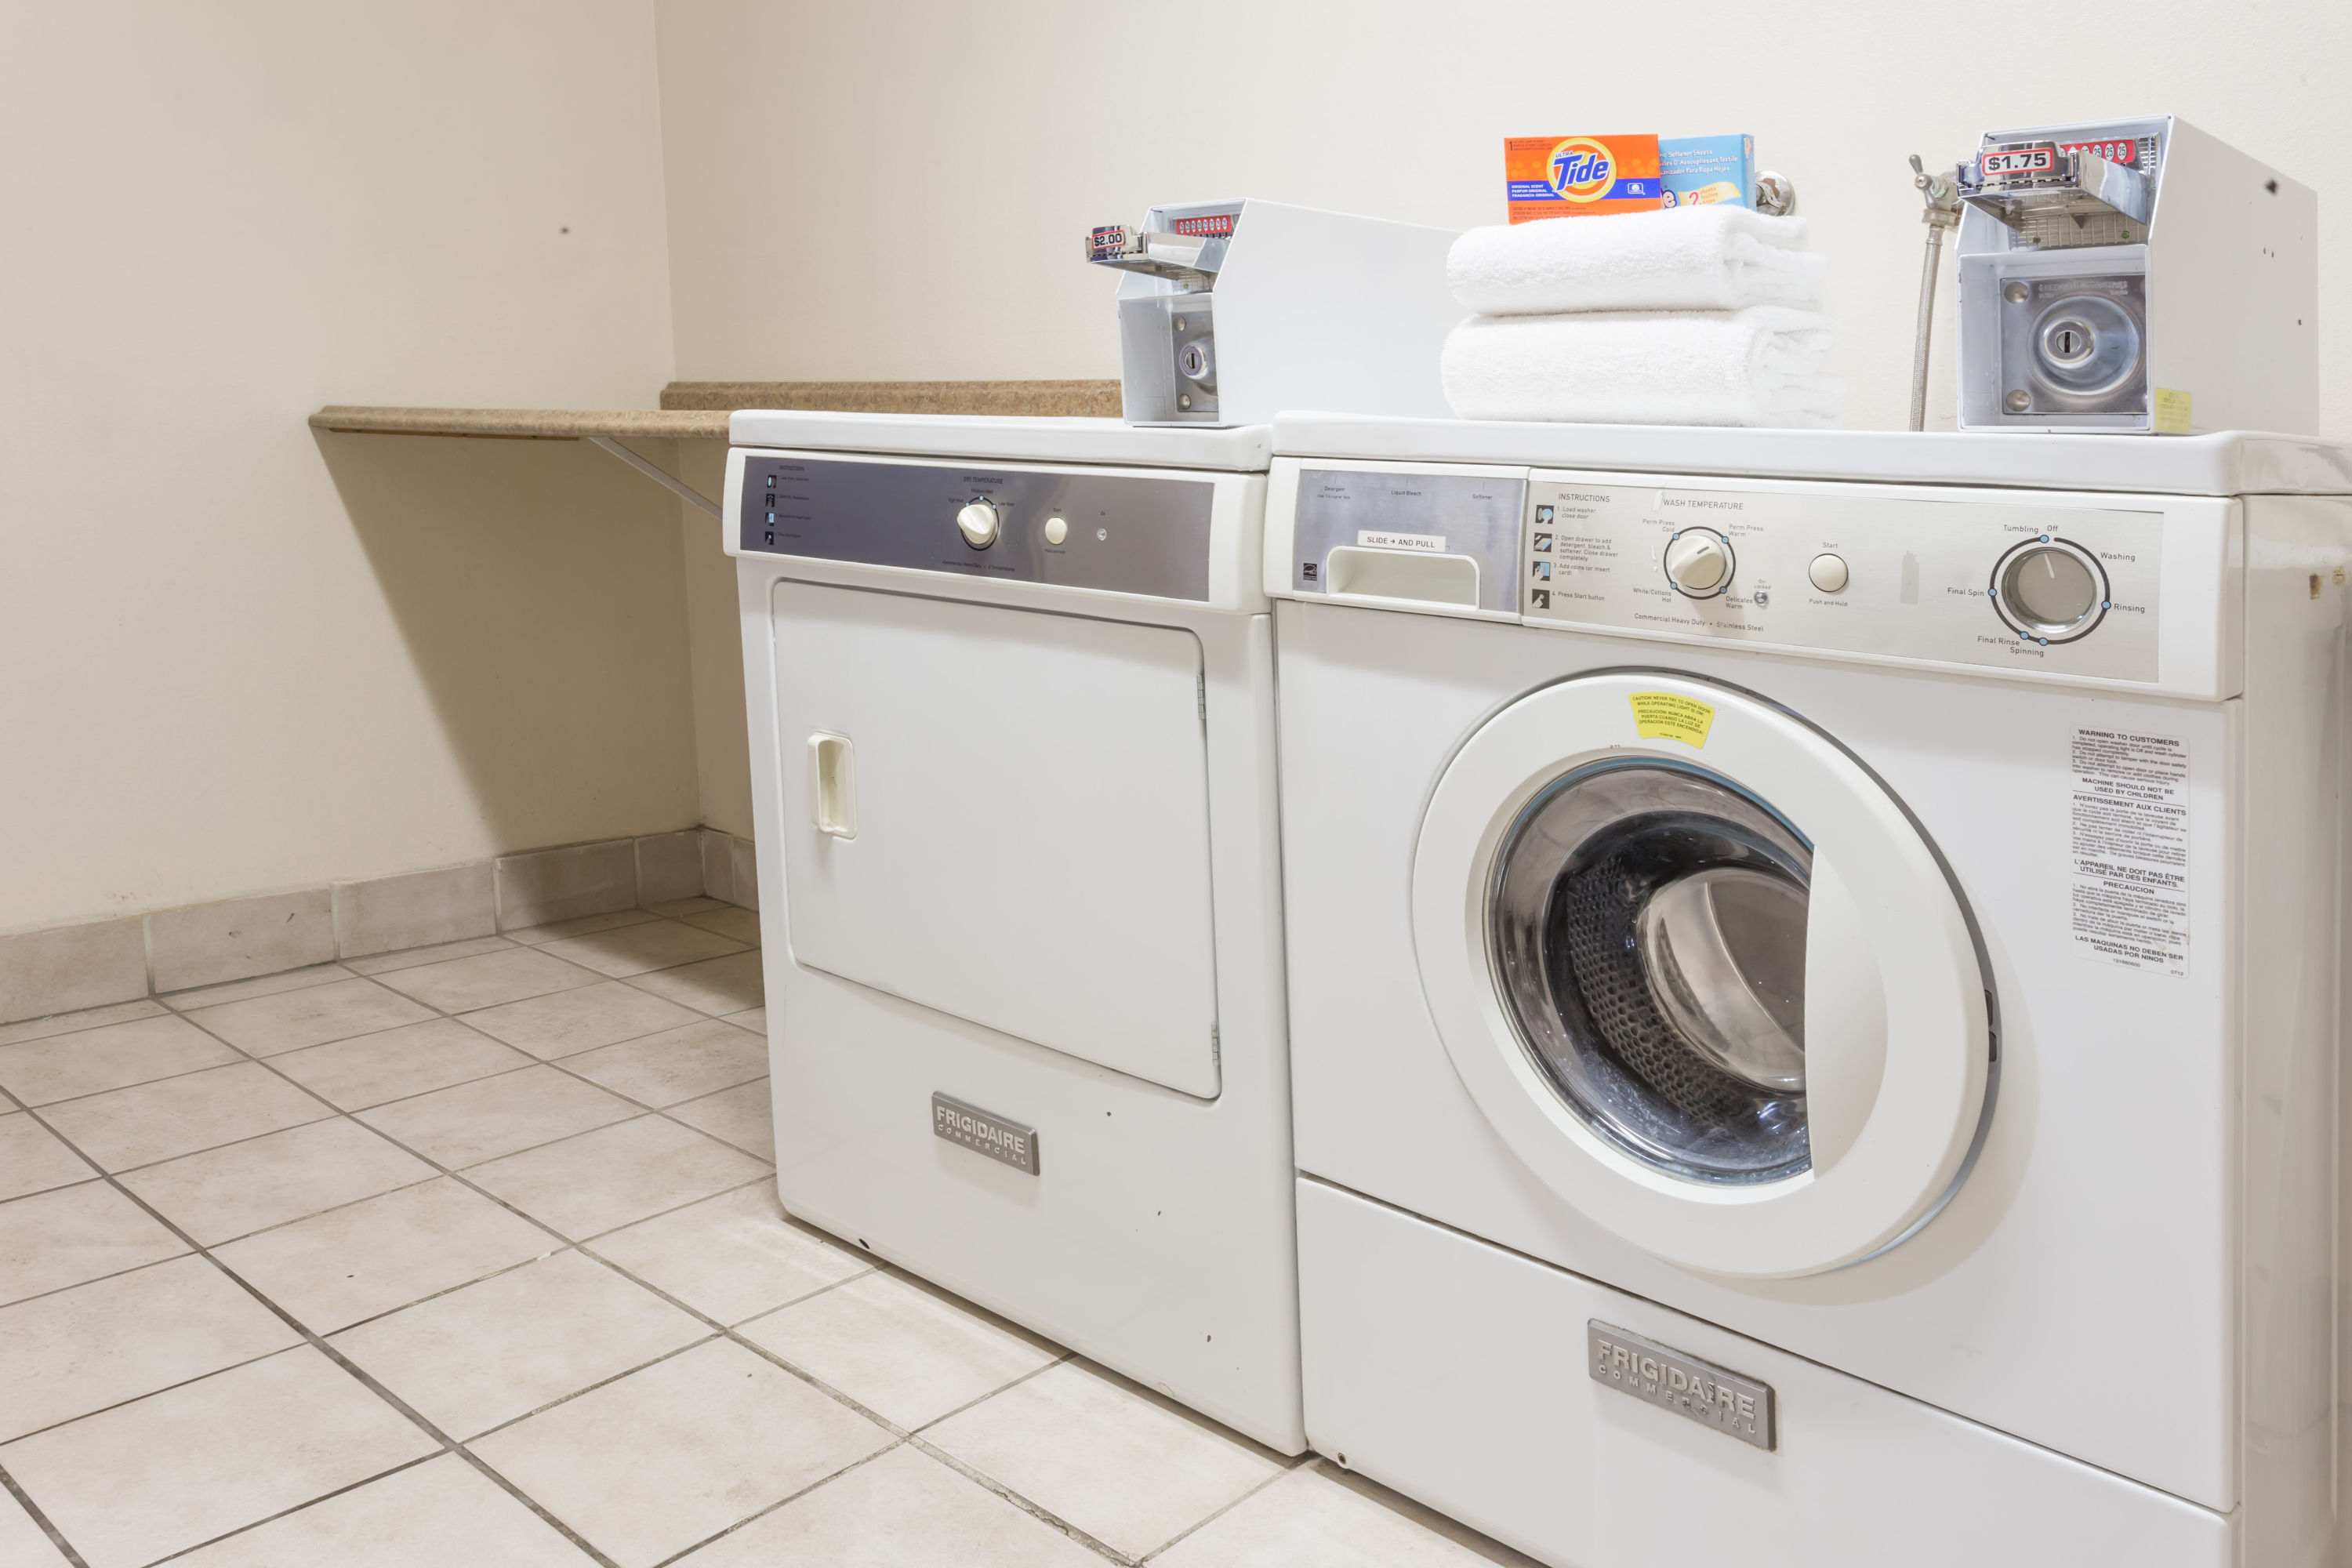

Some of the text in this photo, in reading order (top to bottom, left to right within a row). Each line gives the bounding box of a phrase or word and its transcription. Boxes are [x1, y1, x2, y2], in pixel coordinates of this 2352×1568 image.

[2118, 146, 2125, 156] 25
[1679, 157, 1719, 165] Assouplissant
[1988, 153, 2046, 171] $1.75
[1554, 153, 1610, 191] Tide
[1094, 233, 1123, 247] $2.00
[1558, 493, 1610, 502] INSTRUCTIONS
[1663, 499, 1744, 510] WASH TEMPERATURE
[2003, 524, 2038, 534] Tumbling
[1367, 536, 1388, 544] SLIDE
[1416, 539, 1435, 548] PULL
[2101, 552, 2136, 562] Washing
[1633, 588, 1671, 597] White/Cottons
[1726, 595, 1753, 604] Delicates
[1968, 589, 1984, 597] Spin
[2114, 604, 2145, 614] Rinsing
[1634, 613, 1671, 623] Commercial
[1672, 617, 1690, 626] Heavy
[1691, 619, 1706, 628] Duty
[1717, 621, 1746, 630] Stainless
[1998, 637, 2020, 646] Rinse
[2010, 647, 2044, 657] Spinning
[1698, 705, 1711, 714] DOOR
[2078, 729, 2115, 739] WARNING
[2130, 735, 2180, 747] CUSTOMERS
[2082, 777, 2114, 787] MACHINE
[2116, 782, 2146, 791] SHOULD
[2094, 786, 2114, 794] USED
[2127, 791, 2164, 801] CHILDREN
[2073, 795, 2134, 808] AVERTISSEMENT
[2153, 806, 2187, 816] CLIENTS
[2074, 858, 2116, 871] L'APPAREIL
[2129, 867, 2147, 876] DOIT
[2165, 872, 2185, 882] ÊTRE
[2103, 881, 2155, 895] PRECAUCION
[2142, 877, 2180, 887] ENFANTS.
[2091, 938, 2128, 950] MAQUINAS
[2142, 947, 2167, 958] DEBEN
[2094, 945, 2123, 955] USADAS
[2141, 955, 2164, 964] NINOS
[936, 1105, 1025, 1155] FRIGIDAIRE
[938, 1123, 1026, 1165] COMMERCIAL
[1597, 1339, 1756, 1420] FRIGIDAIRE
[1599, 1364, 1756, 1435] COMMERCIAL
